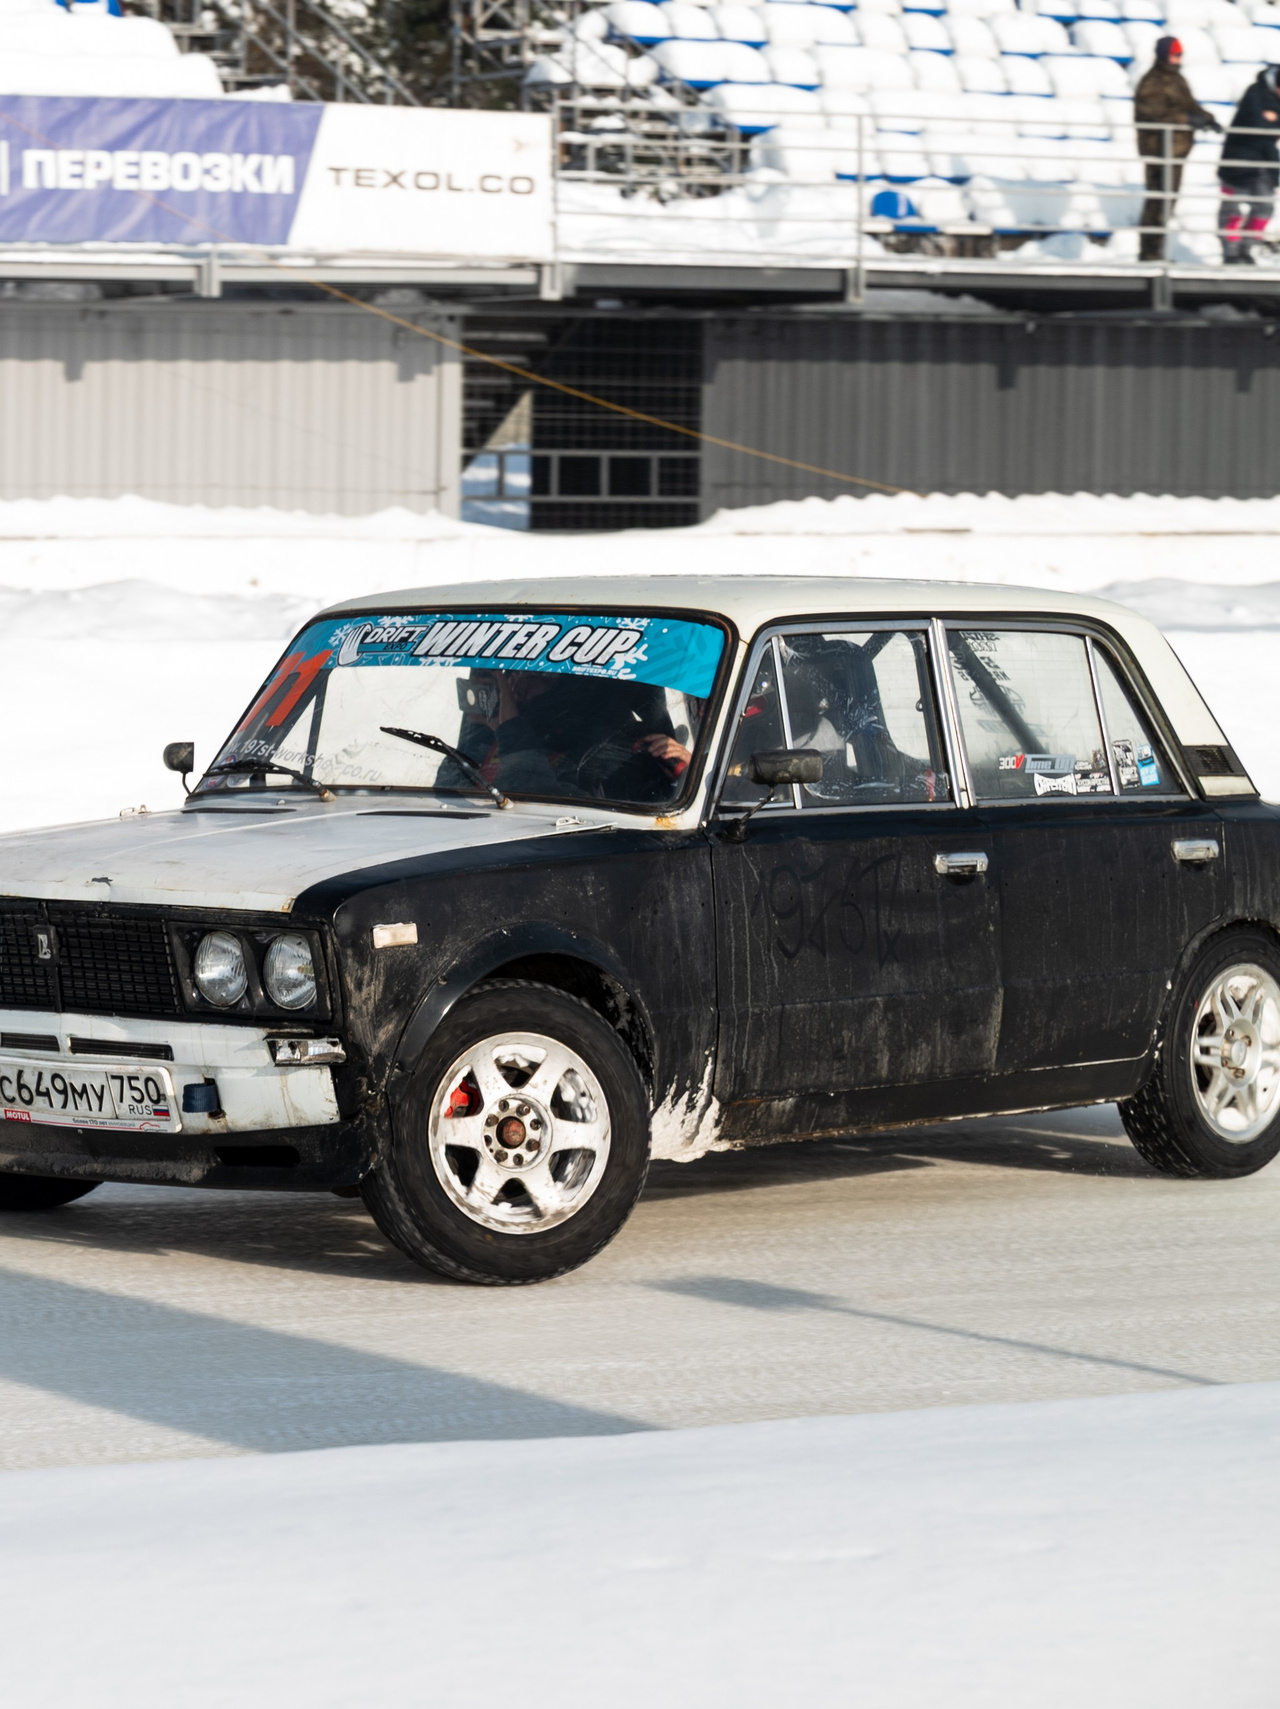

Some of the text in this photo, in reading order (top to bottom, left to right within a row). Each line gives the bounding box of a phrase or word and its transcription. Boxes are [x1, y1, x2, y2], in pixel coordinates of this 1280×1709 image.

[22, 148, 295, 195] ПЕРЕВОЗКИ
[327, 166, 536, 195] TEXOL.CO
[363, 620, 643, 665] DRIFT WINTER CUP
[998, 753, 1025, 770] 300V
[110, 1074, 162, 1105] 750
[6, 1111, 30, 1121] MOTUL
[129, 1104, 153, 1116] RUS
